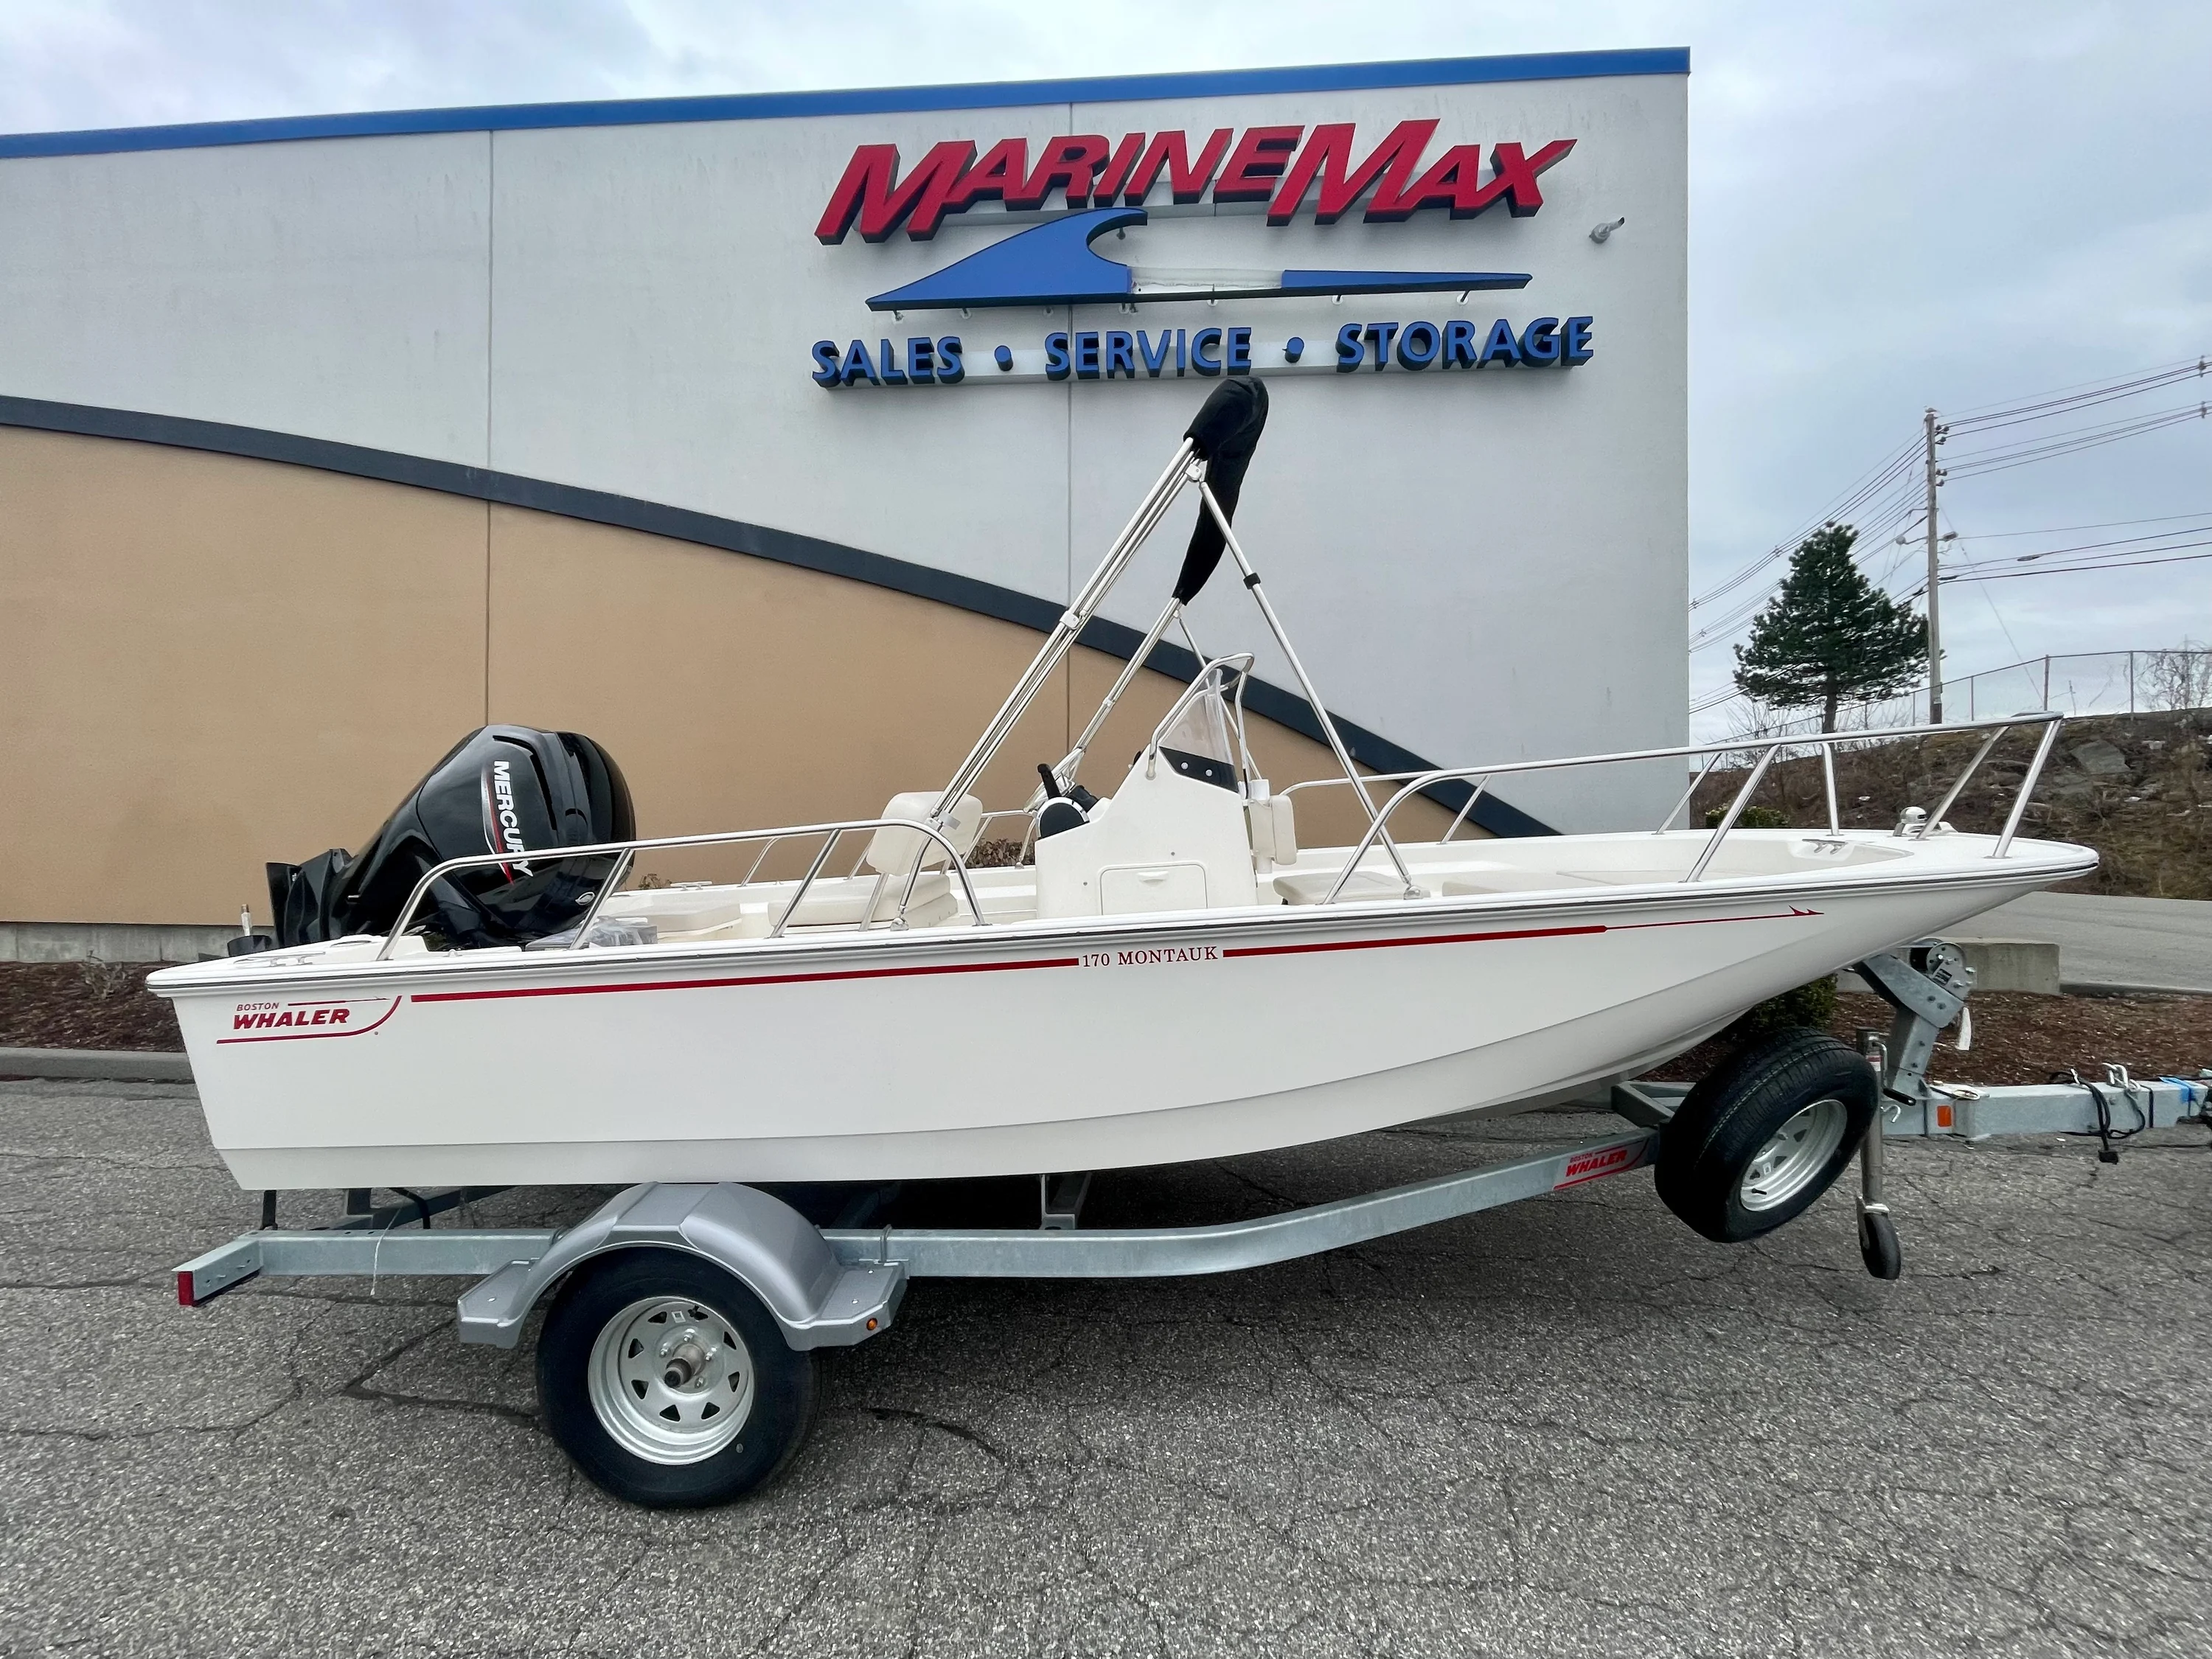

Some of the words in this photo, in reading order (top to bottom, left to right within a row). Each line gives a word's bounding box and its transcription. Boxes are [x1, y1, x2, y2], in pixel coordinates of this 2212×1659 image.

[812, 336, 963, 386] SALES
[1045, 327, 1252, 379] SERVICE
[1335, 316, 1594, 375] STORAGE
[1083, 953, 1110, 967] 170
[1119, 947, 1218, 965] MONTAUK
[236, 1002, 279, 1012] BOSTON
[234, 1009, 350, 1029] WHALER
[1565, 1150, 1627, 1177] WHALER
